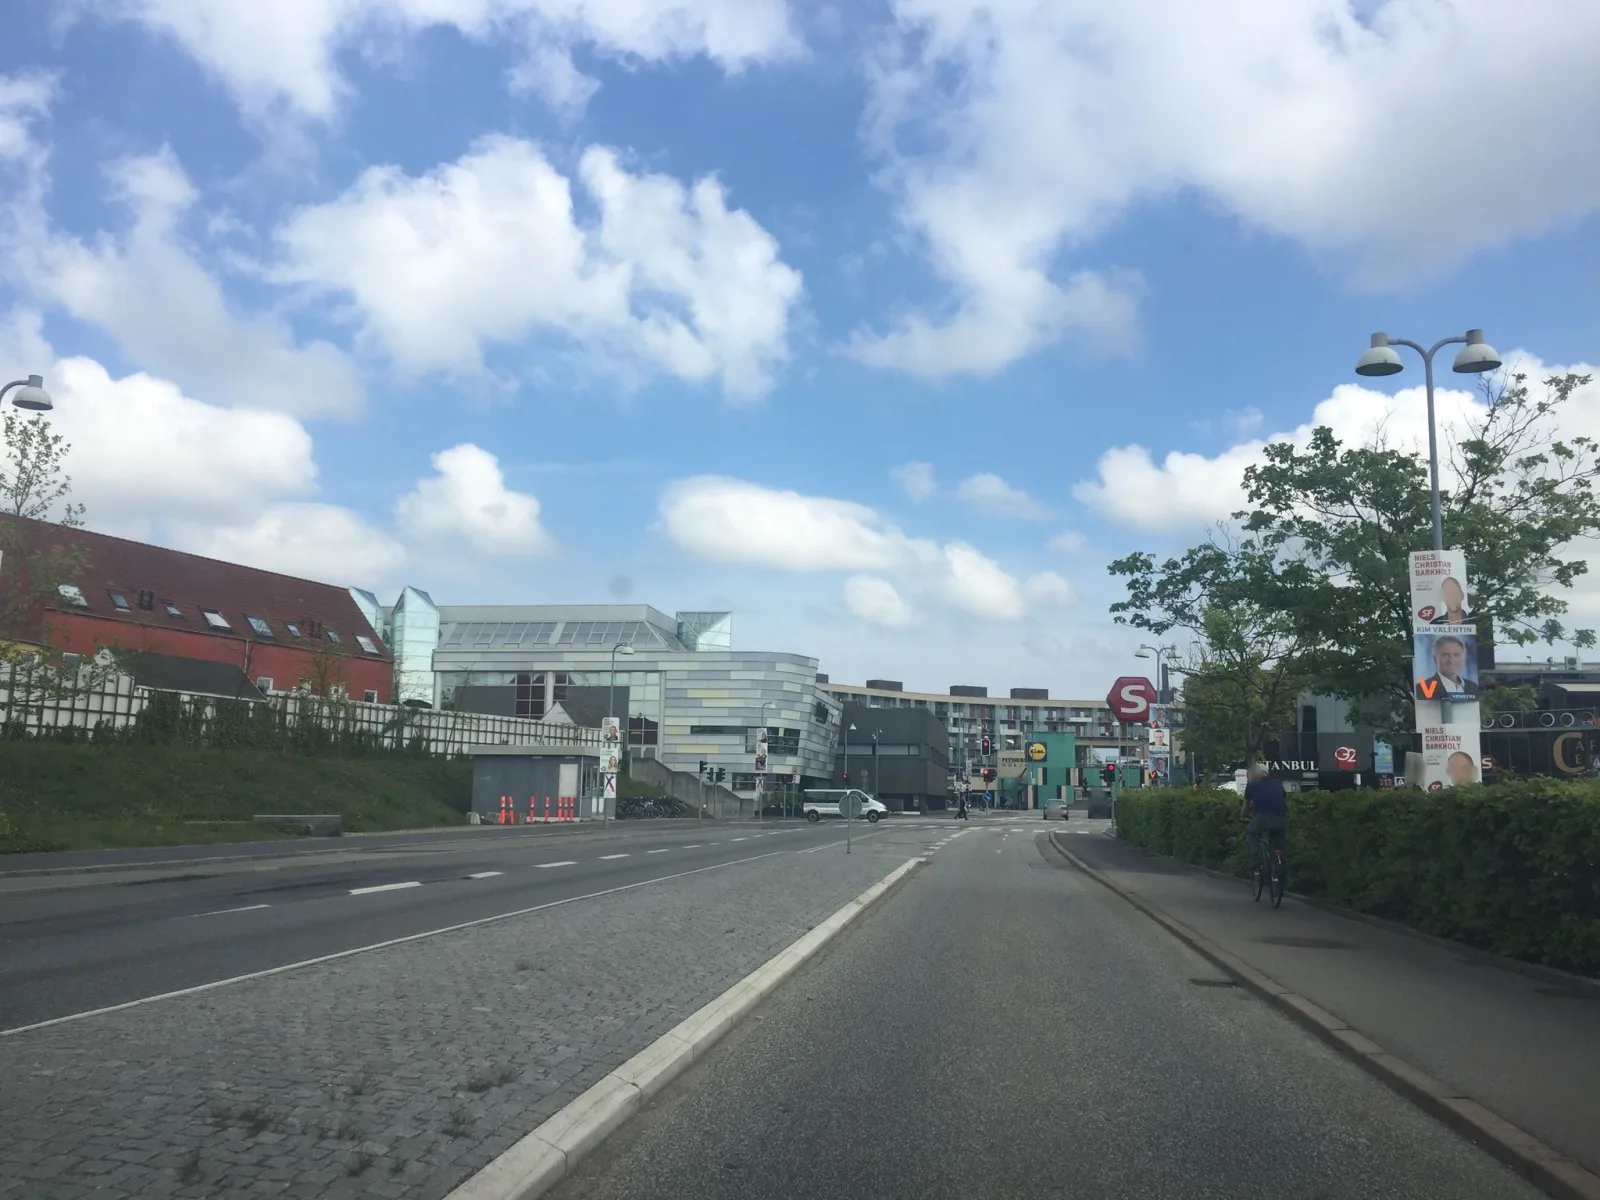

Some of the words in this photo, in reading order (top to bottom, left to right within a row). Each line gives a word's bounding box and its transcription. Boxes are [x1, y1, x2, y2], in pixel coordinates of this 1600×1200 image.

[1414, 553, 1436, 561] NIELS
[1414, 561, 1452, 569] CHRISTIAN
[1421, 609, 1433, 618] SF
[1418, 676, 1438, 698] V
[1120, 685, 1147, 713] S
